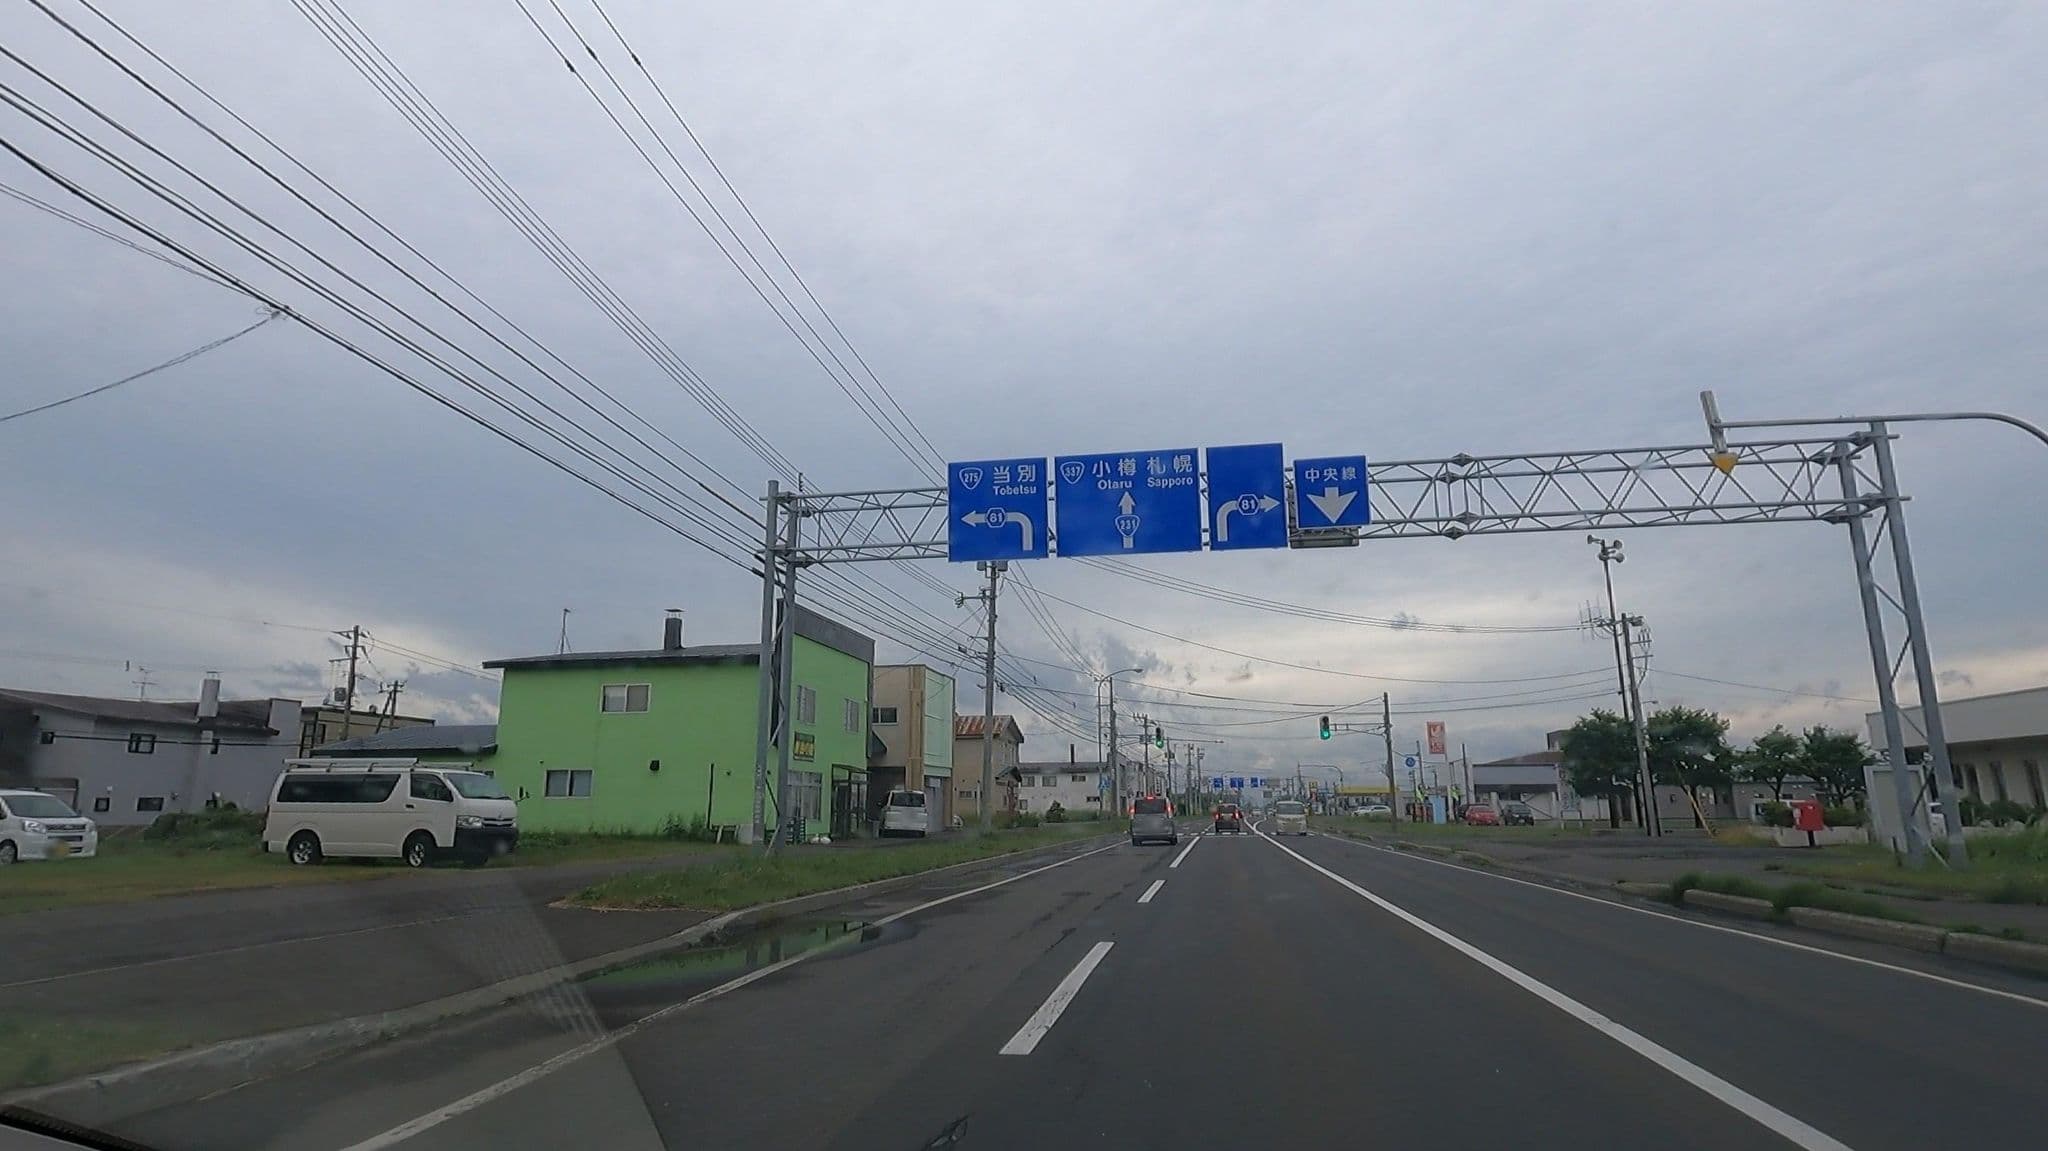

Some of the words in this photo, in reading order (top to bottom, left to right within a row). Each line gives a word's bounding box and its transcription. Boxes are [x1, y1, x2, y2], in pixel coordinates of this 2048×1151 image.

[1064, 466, 1081, 477] 337
[1092, 457, 1137, 478] 小樽
[1146, 454, 1193, 475] 札幌
[964, 472, 979, 483] 275
[993, 463, 1036, 484] 当別
[1304, 466, 1357, 483] 中央線
[1097, 479, 1132, 490] Otaru
[1147, 476, 1194, 489] Sapporo
[992, 484, 1037, 496] Tobetsu
[1241, 499, 1256, 510] 81
[989, 512, 1003, 523] 81
[1119, 519, 1136, 530] 231
